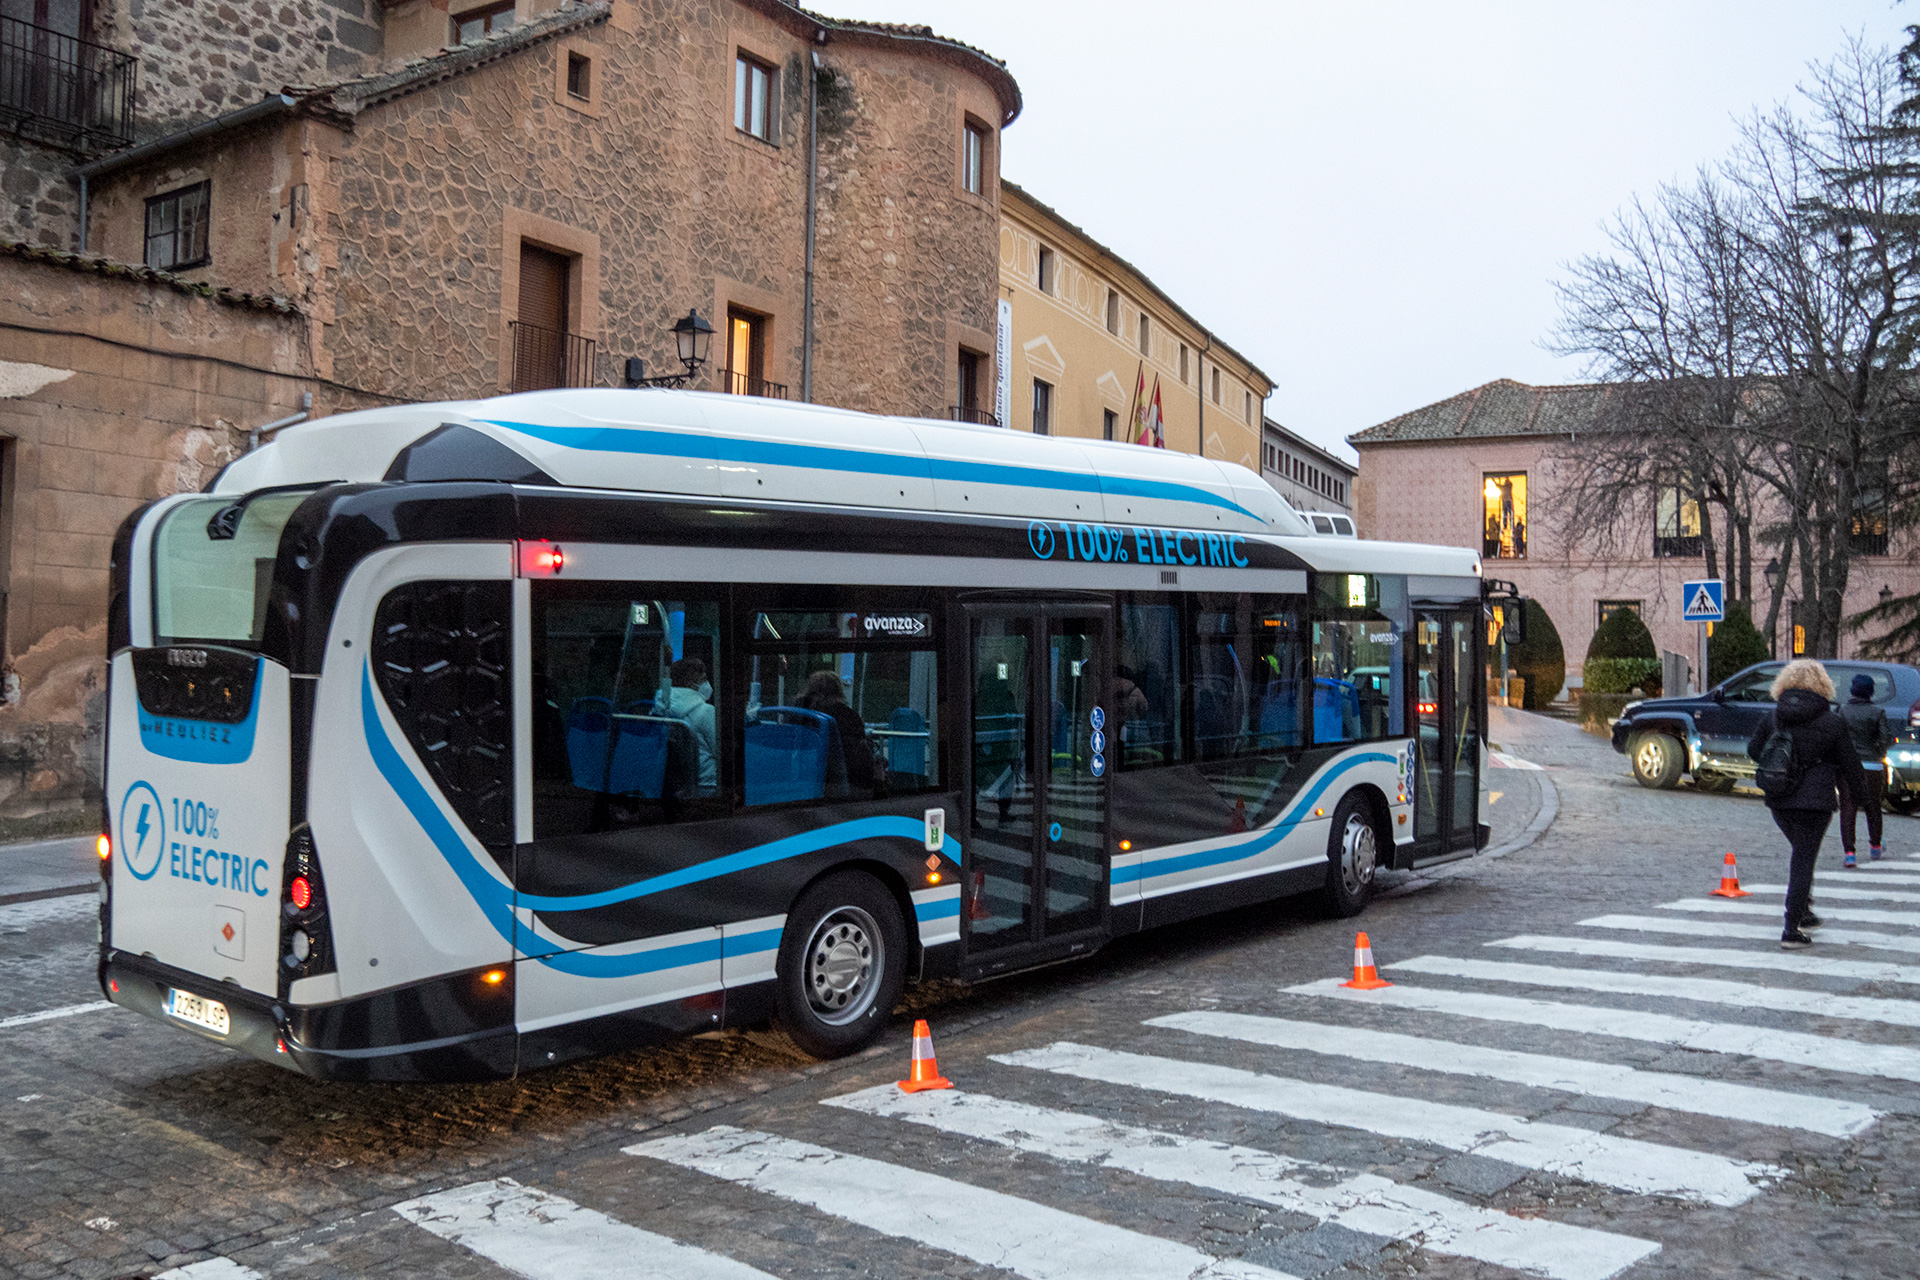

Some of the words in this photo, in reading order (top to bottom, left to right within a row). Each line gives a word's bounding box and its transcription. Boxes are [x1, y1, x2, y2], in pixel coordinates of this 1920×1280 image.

[1059, 522, 1128, 563] 100%
[1132, 528, 1249, 568] ELECTRIC
[864, 616, 913, 630] avanza
[155, 721, 231, 744] HEULIEZ
[172, 797, 219, 840] 100%
[171, 843, 269, 897] ELECTRIC
